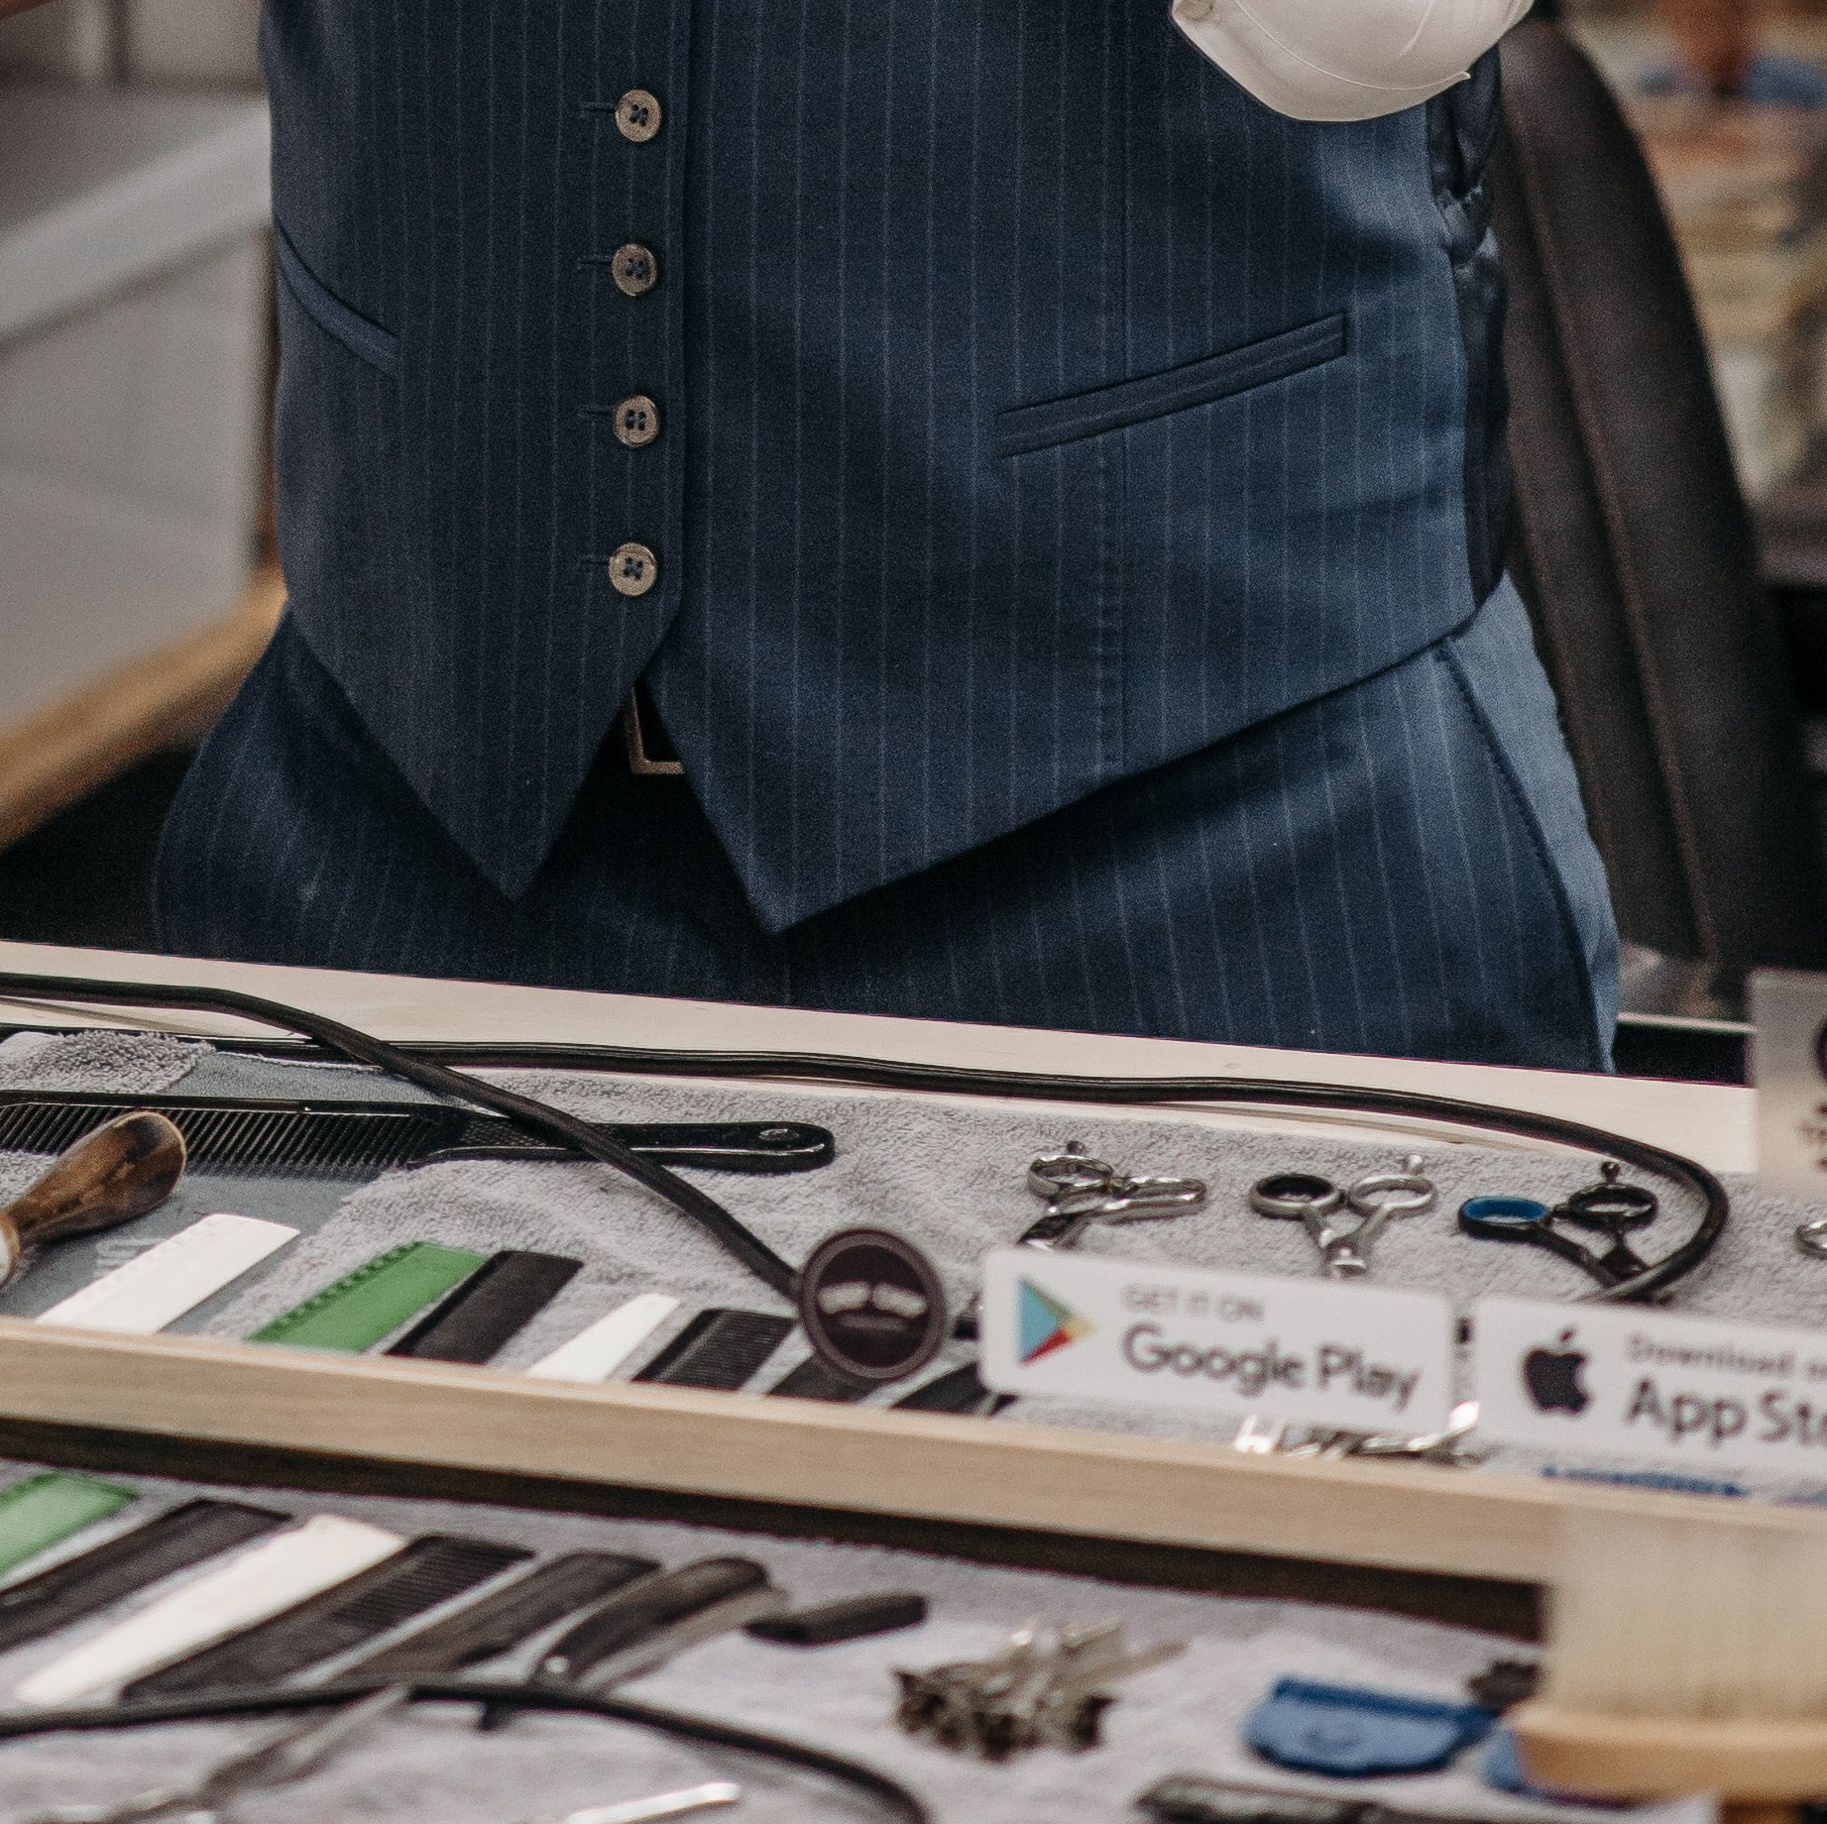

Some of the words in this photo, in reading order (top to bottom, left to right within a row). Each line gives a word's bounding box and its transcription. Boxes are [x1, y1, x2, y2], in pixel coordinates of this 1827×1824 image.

[1123, 1285, 1176, 1314] GET
[1186, 1290, 1209, 1317] IT
[1218, 1296, 1264, 1322] ON
[1122, 1322, 1304, 1397] Google
[1316, 1344, 1420, 1411] Play
[1629, 1332, 1794, 1375] Download
[1626, 1376, 1749, 1446] App
